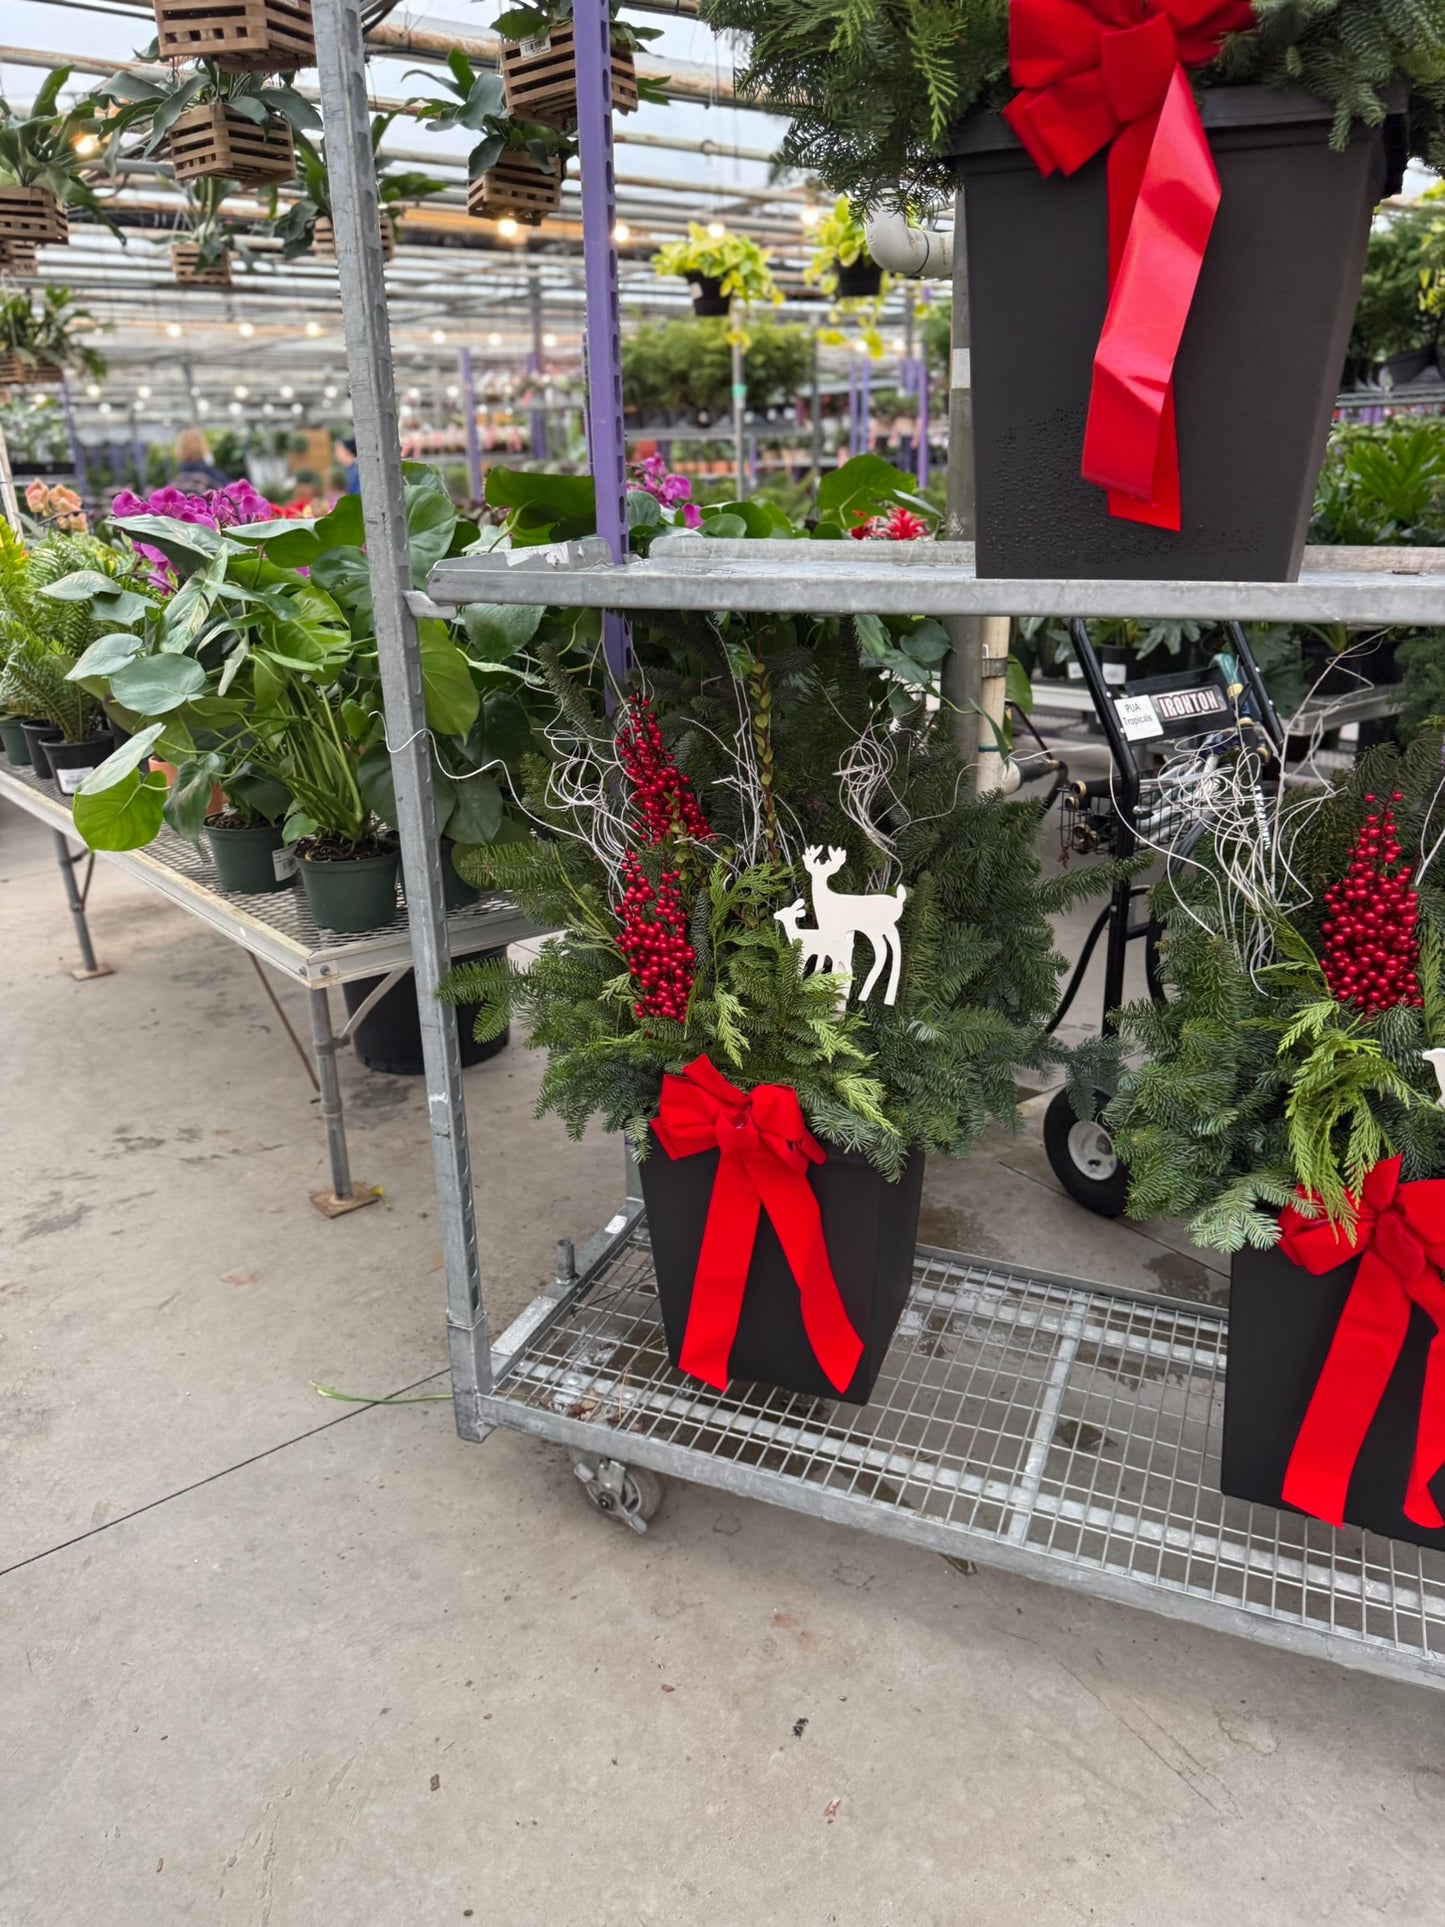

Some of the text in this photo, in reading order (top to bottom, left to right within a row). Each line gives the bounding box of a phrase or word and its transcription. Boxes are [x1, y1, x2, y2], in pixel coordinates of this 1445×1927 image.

[1125, 703, 1141, 713] PUA
[1158, 690, 1220, 718] IRONTON
[1123, 714, 1152, 726] Tropicals
